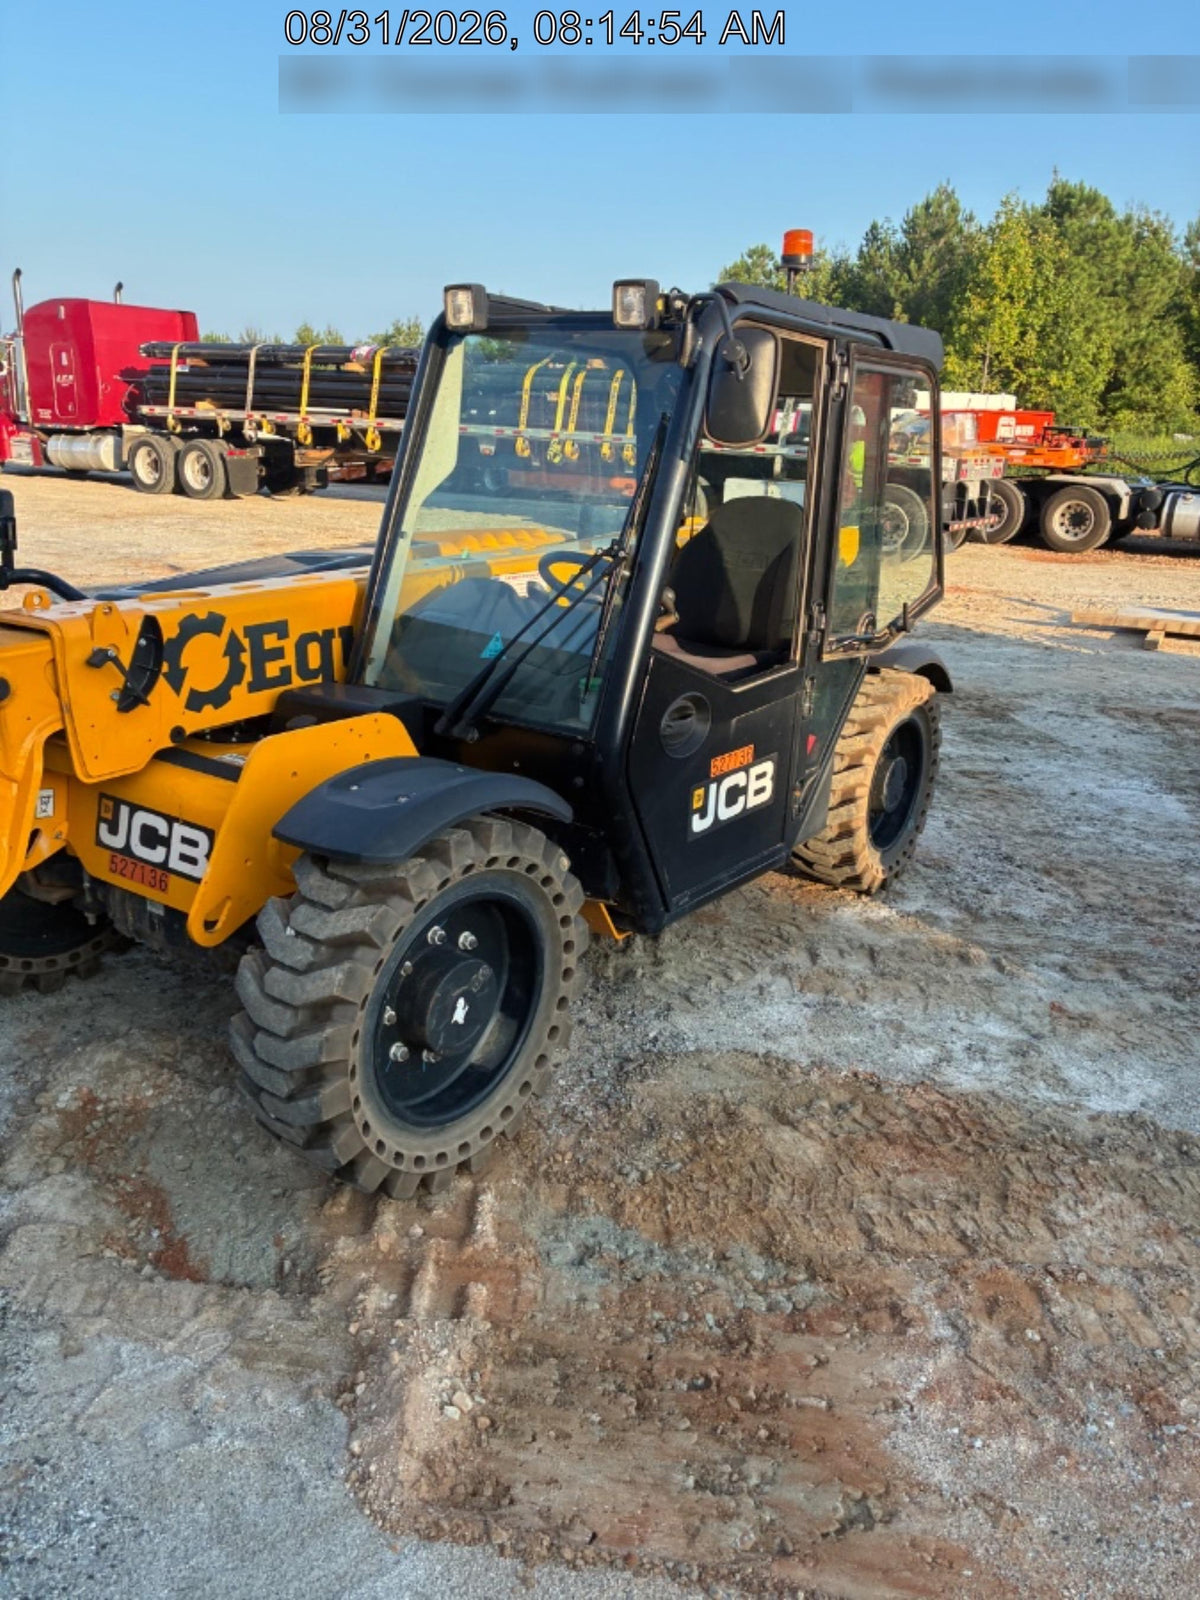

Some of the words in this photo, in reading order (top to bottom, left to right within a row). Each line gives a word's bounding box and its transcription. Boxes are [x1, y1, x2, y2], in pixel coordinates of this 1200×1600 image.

[692, 760, 774, 832] JCB
[98, 804, 210, 879] JCB
[110, 853, 169, 892] 527136
